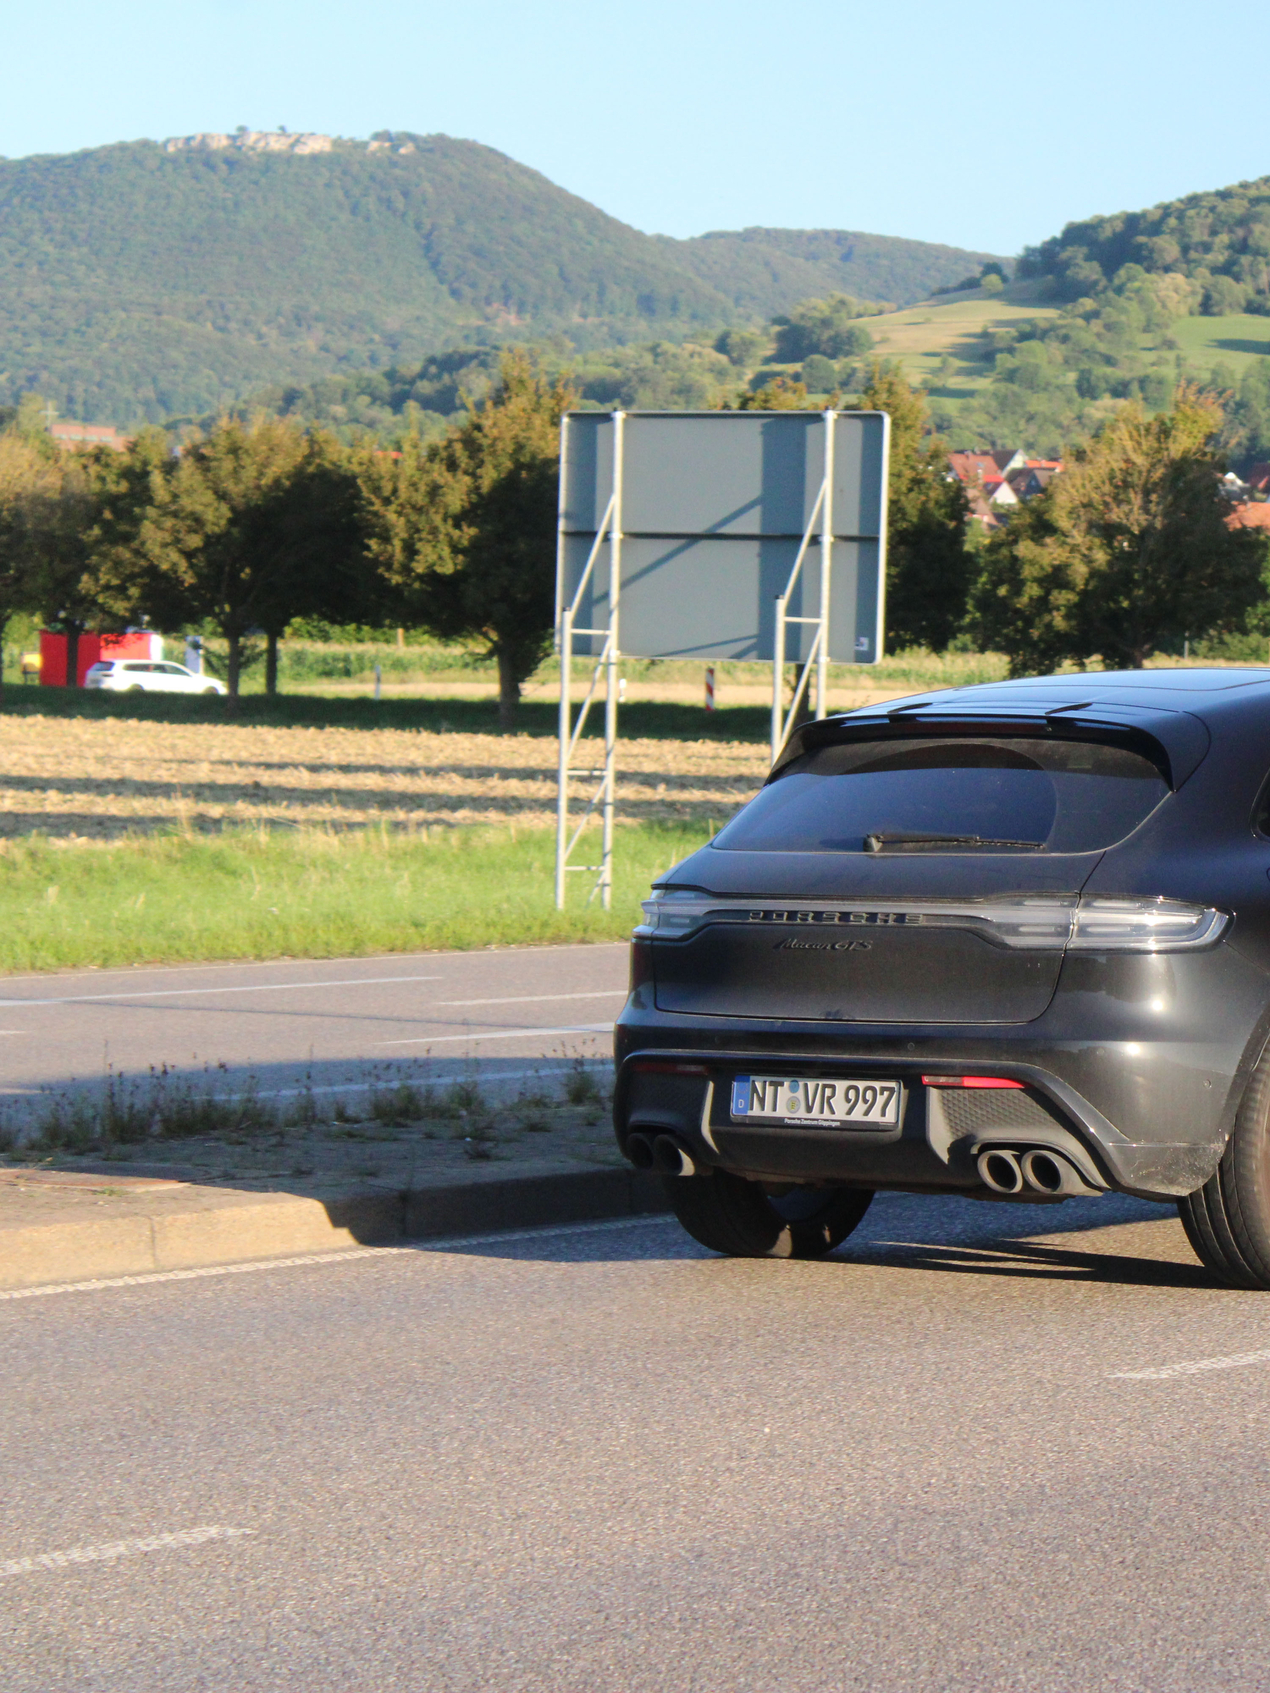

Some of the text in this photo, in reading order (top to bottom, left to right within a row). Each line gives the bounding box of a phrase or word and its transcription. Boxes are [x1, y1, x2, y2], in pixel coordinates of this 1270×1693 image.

[749, 911, 923, 924] PORSCHE
[778, 938, 874, 950] Macan GTS
[738, 1080, 897, 1118] D NT VR 997
